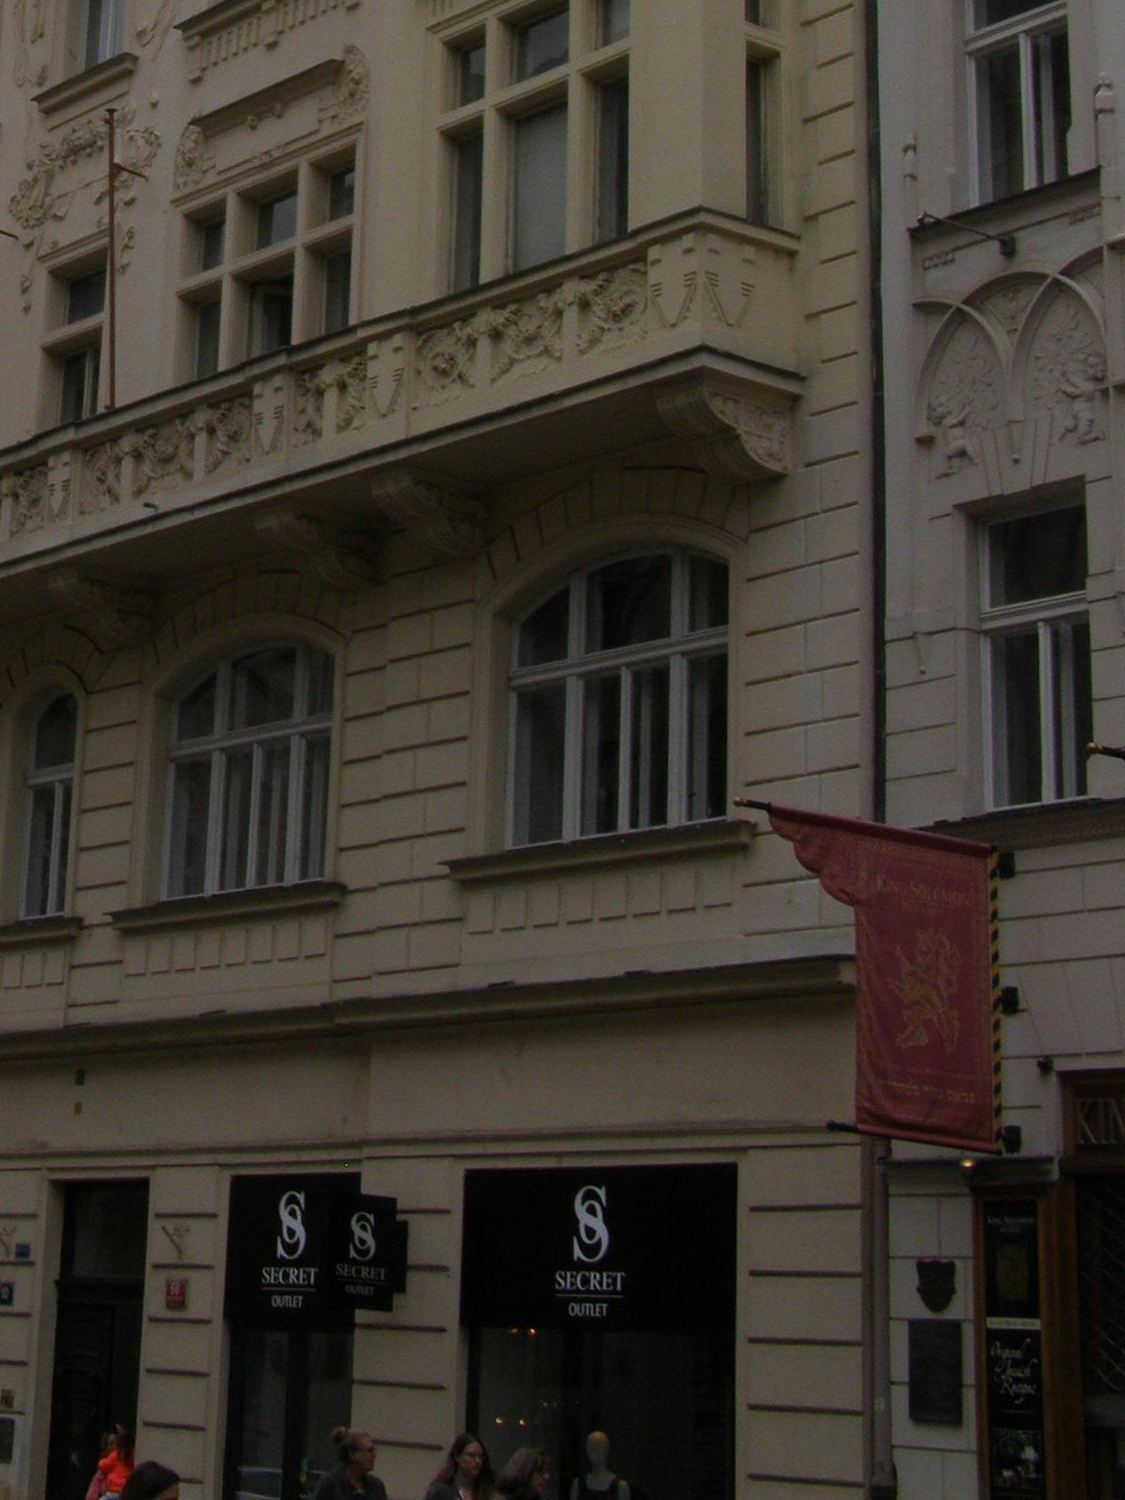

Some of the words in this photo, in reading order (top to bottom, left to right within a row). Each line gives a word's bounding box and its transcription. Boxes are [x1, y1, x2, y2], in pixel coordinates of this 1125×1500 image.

[261, 1266, 320, 1285] SECRET
[335, 1263, 388, 1281] SECRET
[554, 1270, 626, 1291] SECRET
[345, 1284, 377, 1296] OUTLET
[271, 1295, 305, 1309] OUTLET
[568, 1302, 609, 1317] OUTLET
